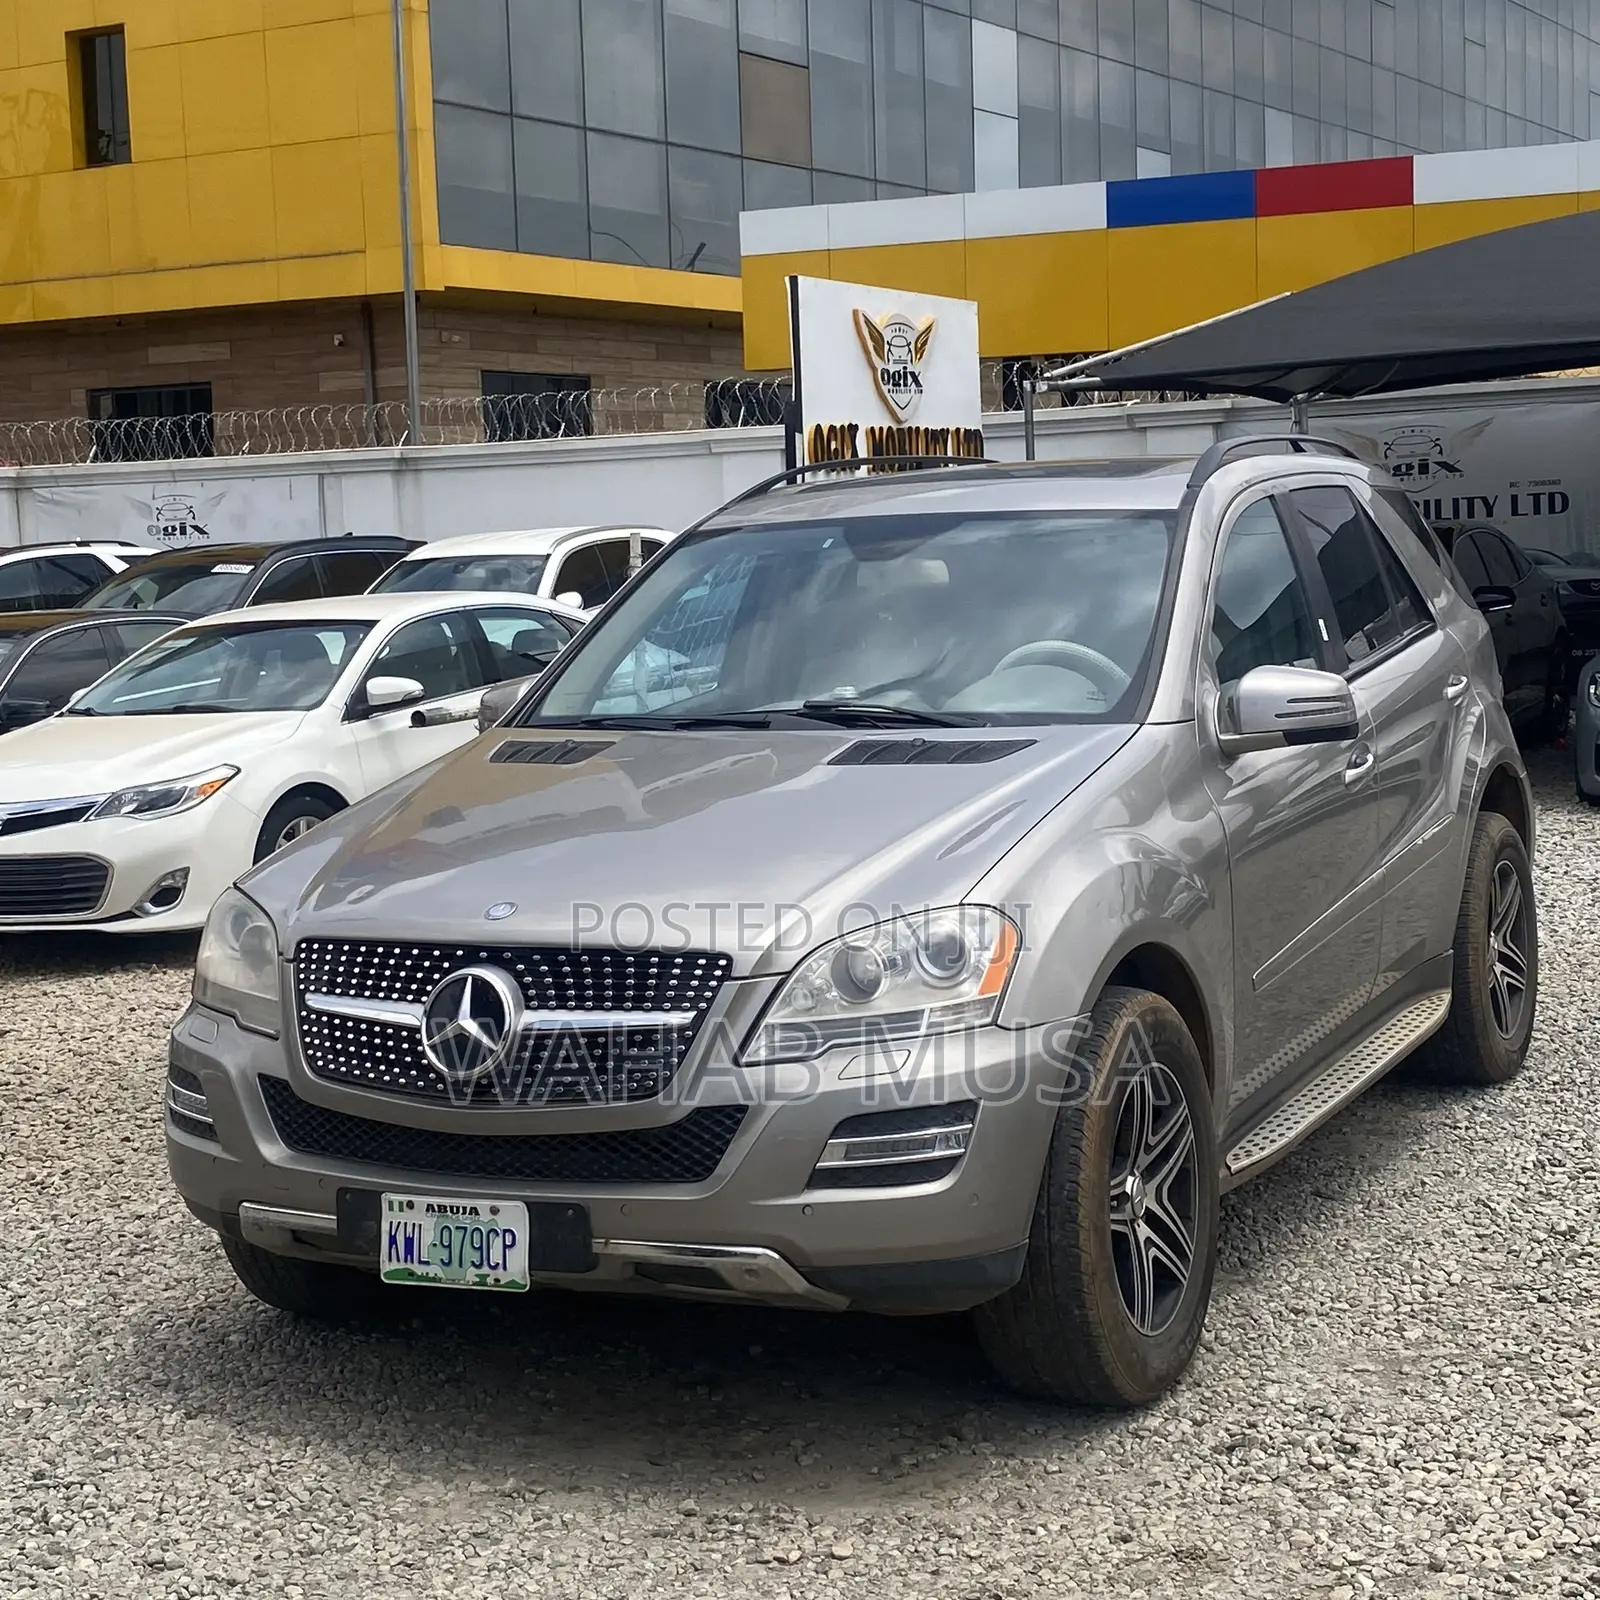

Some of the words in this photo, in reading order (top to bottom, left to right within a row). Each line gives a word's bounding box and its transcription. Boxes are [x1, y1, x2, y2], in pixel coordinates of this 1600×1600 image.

[1413, 494, 1498, 520] ILITY
[1510, 491, 1570, 516] LTD
[425, 1203, 480, 1216] ABUJA
